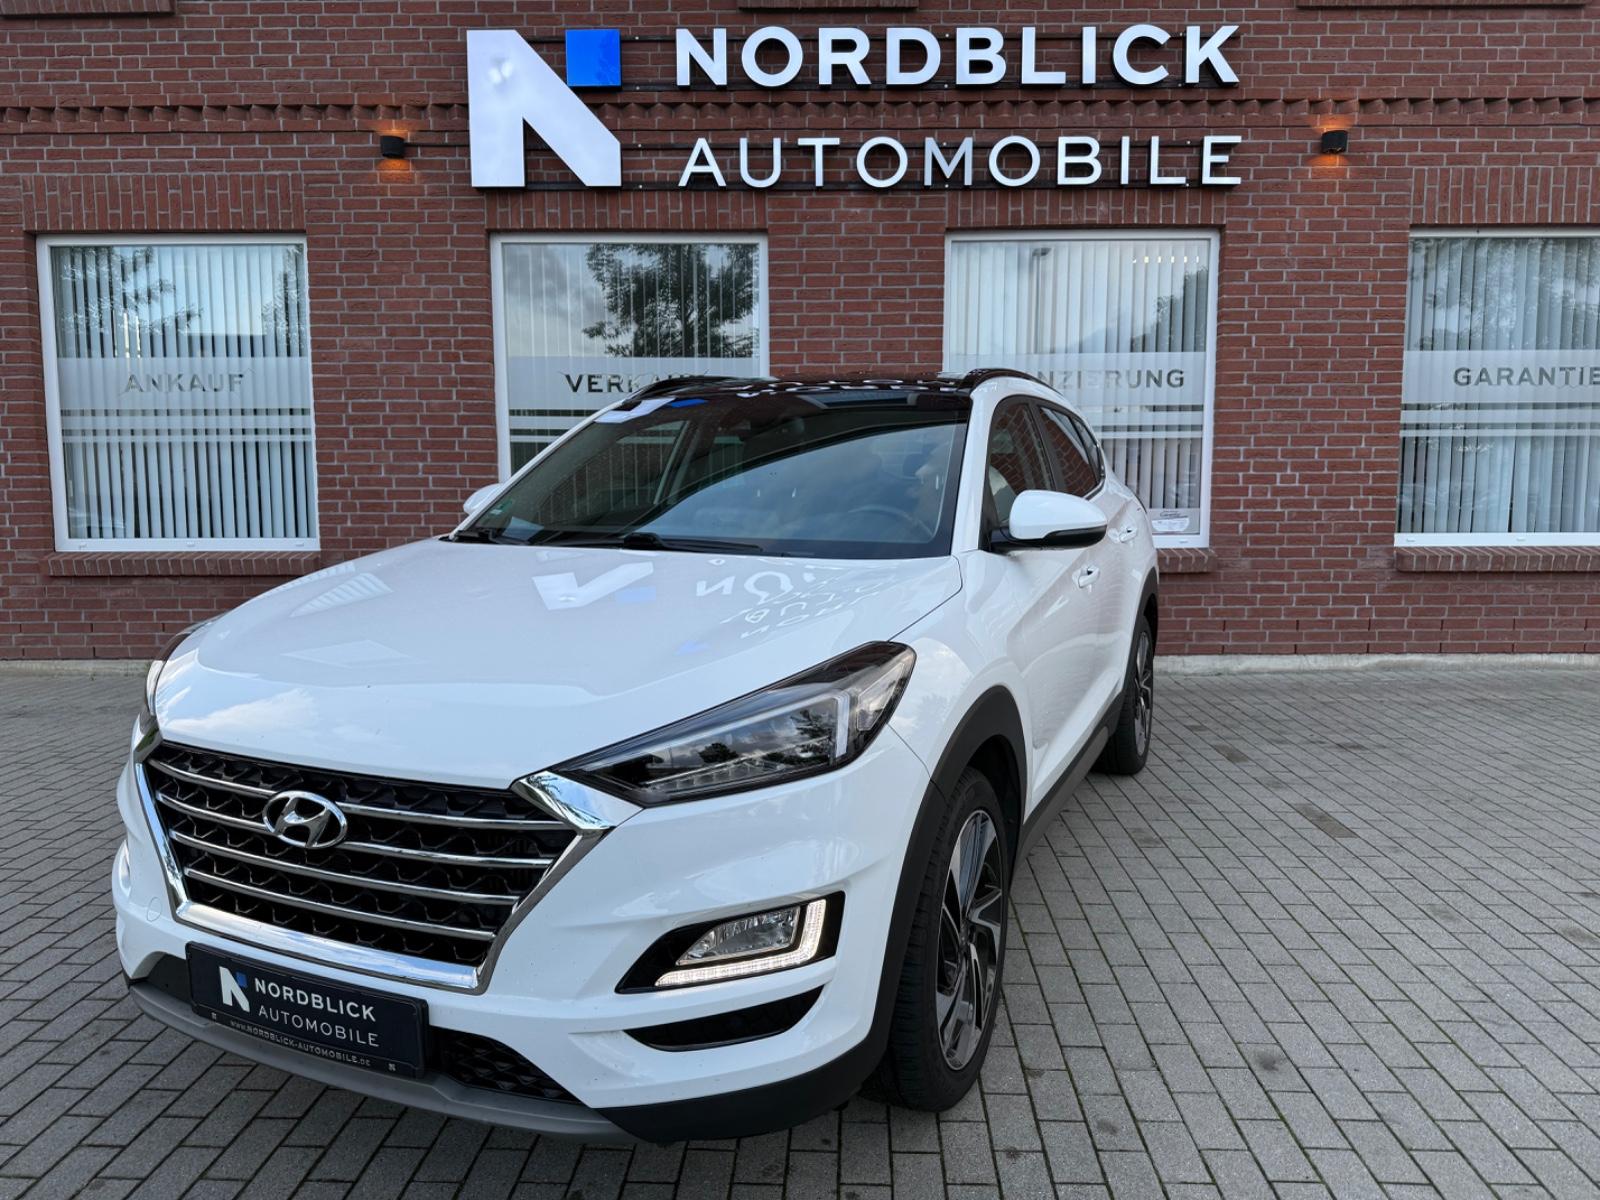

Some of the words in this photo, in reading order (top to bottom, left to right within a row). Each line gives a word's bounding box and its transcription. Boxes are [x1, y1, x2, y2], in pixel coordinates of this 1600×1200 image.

[675, 24, 1240, 88] NORDBLICK
[677, 135, 1242, 189] AUTOMOBILE
[125, 373, 244, 393] ANKAUF
[1036, 368, 1186, 389] NZIERUNG
[1453, 366, 1600, 387] GARANTIE
[254, 977, 377, 1022] NORDBLICK
[258, 1005, 380, 1047] AUTOMOBILE
